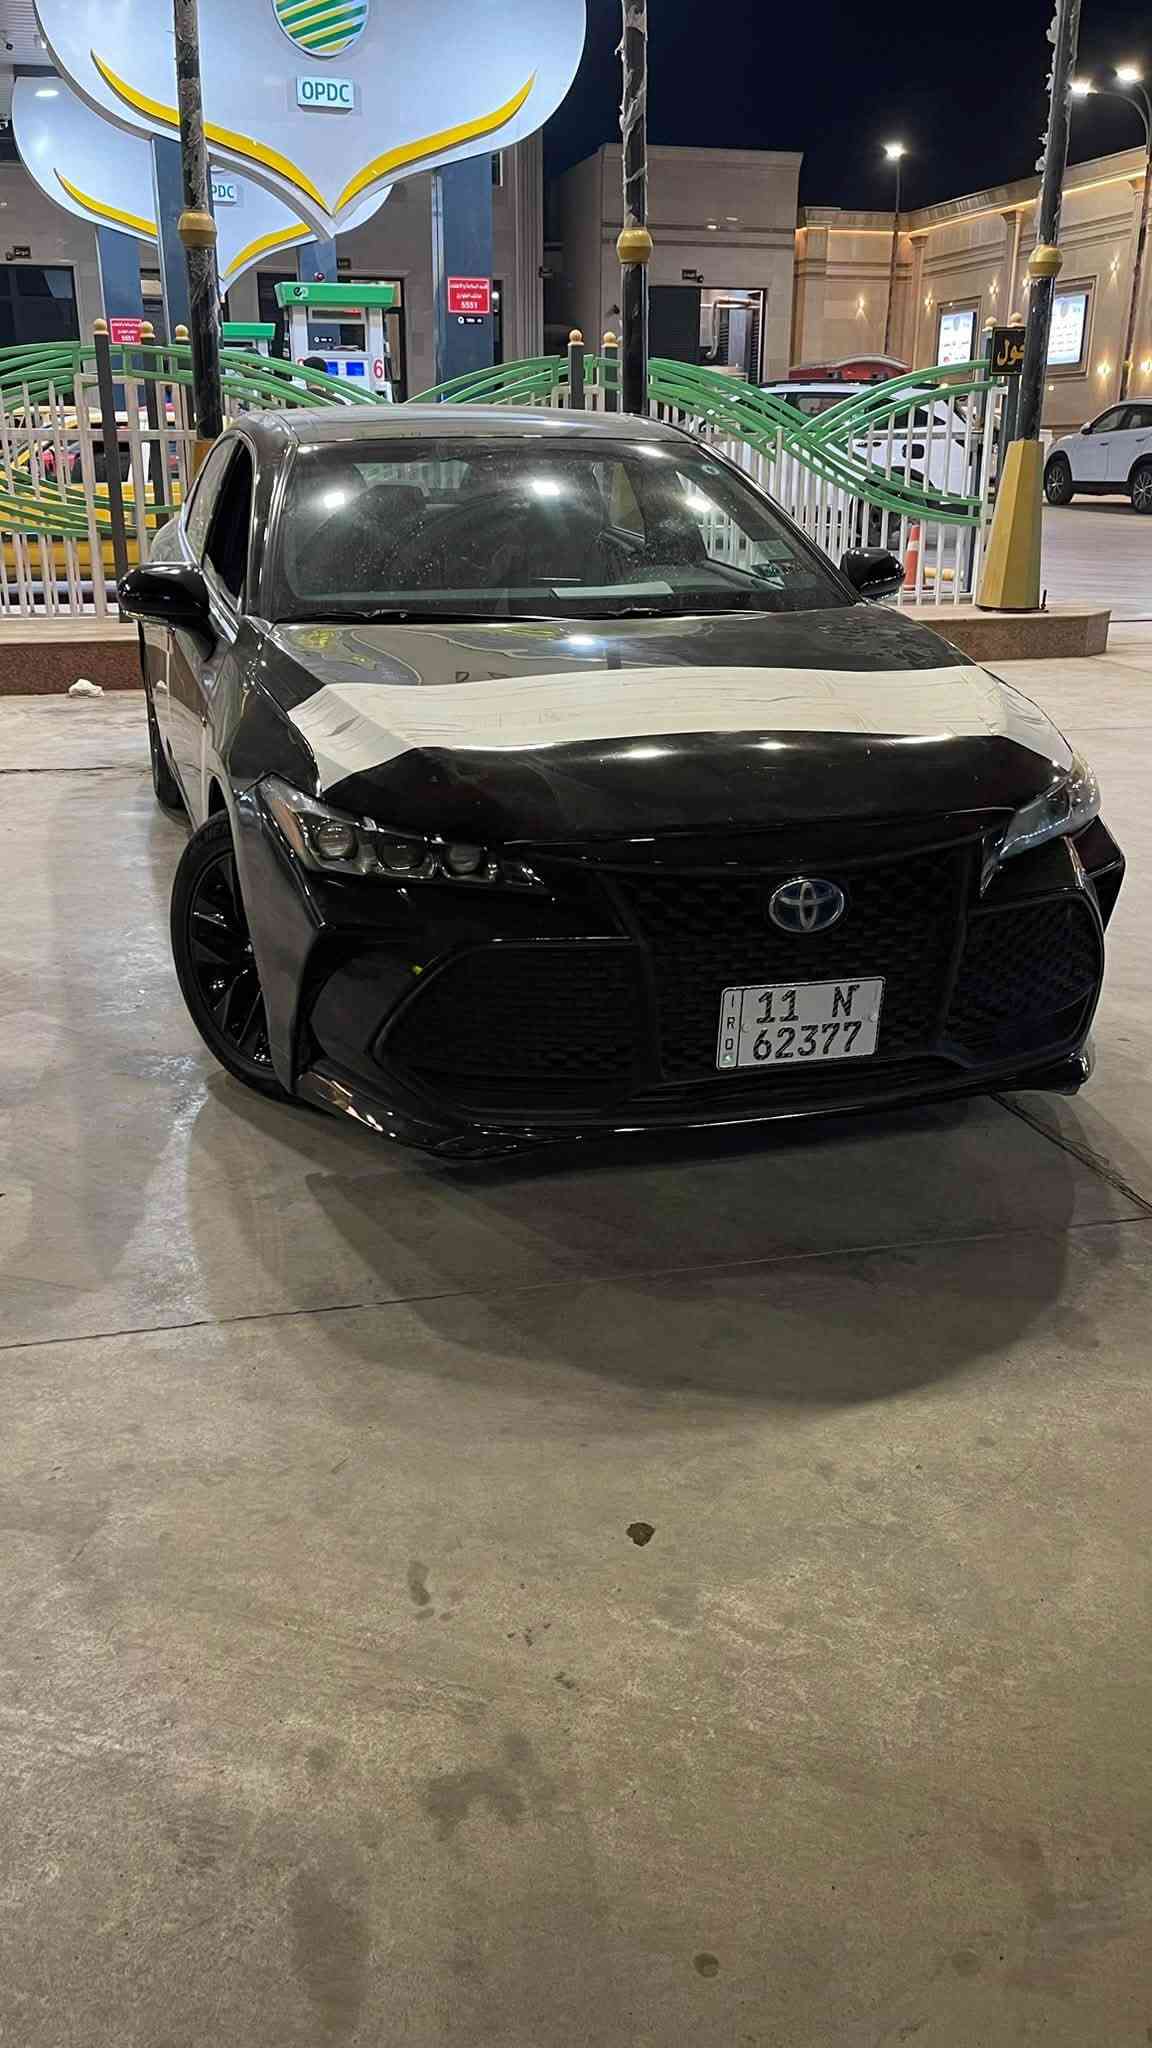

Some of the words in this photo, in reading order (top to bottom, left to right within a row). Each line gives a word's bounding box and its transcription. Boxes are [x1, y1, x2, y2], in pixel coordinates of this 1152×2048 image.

[301, 80, 351, 103] OPDC
[211, 184, 235, 199] PDC
[374, 359, 383, 378] 6
[756, 989, 800, 1025] 11
[831, 983, 861, 1018] N
[752, 1020, 863, 1061] 62377
